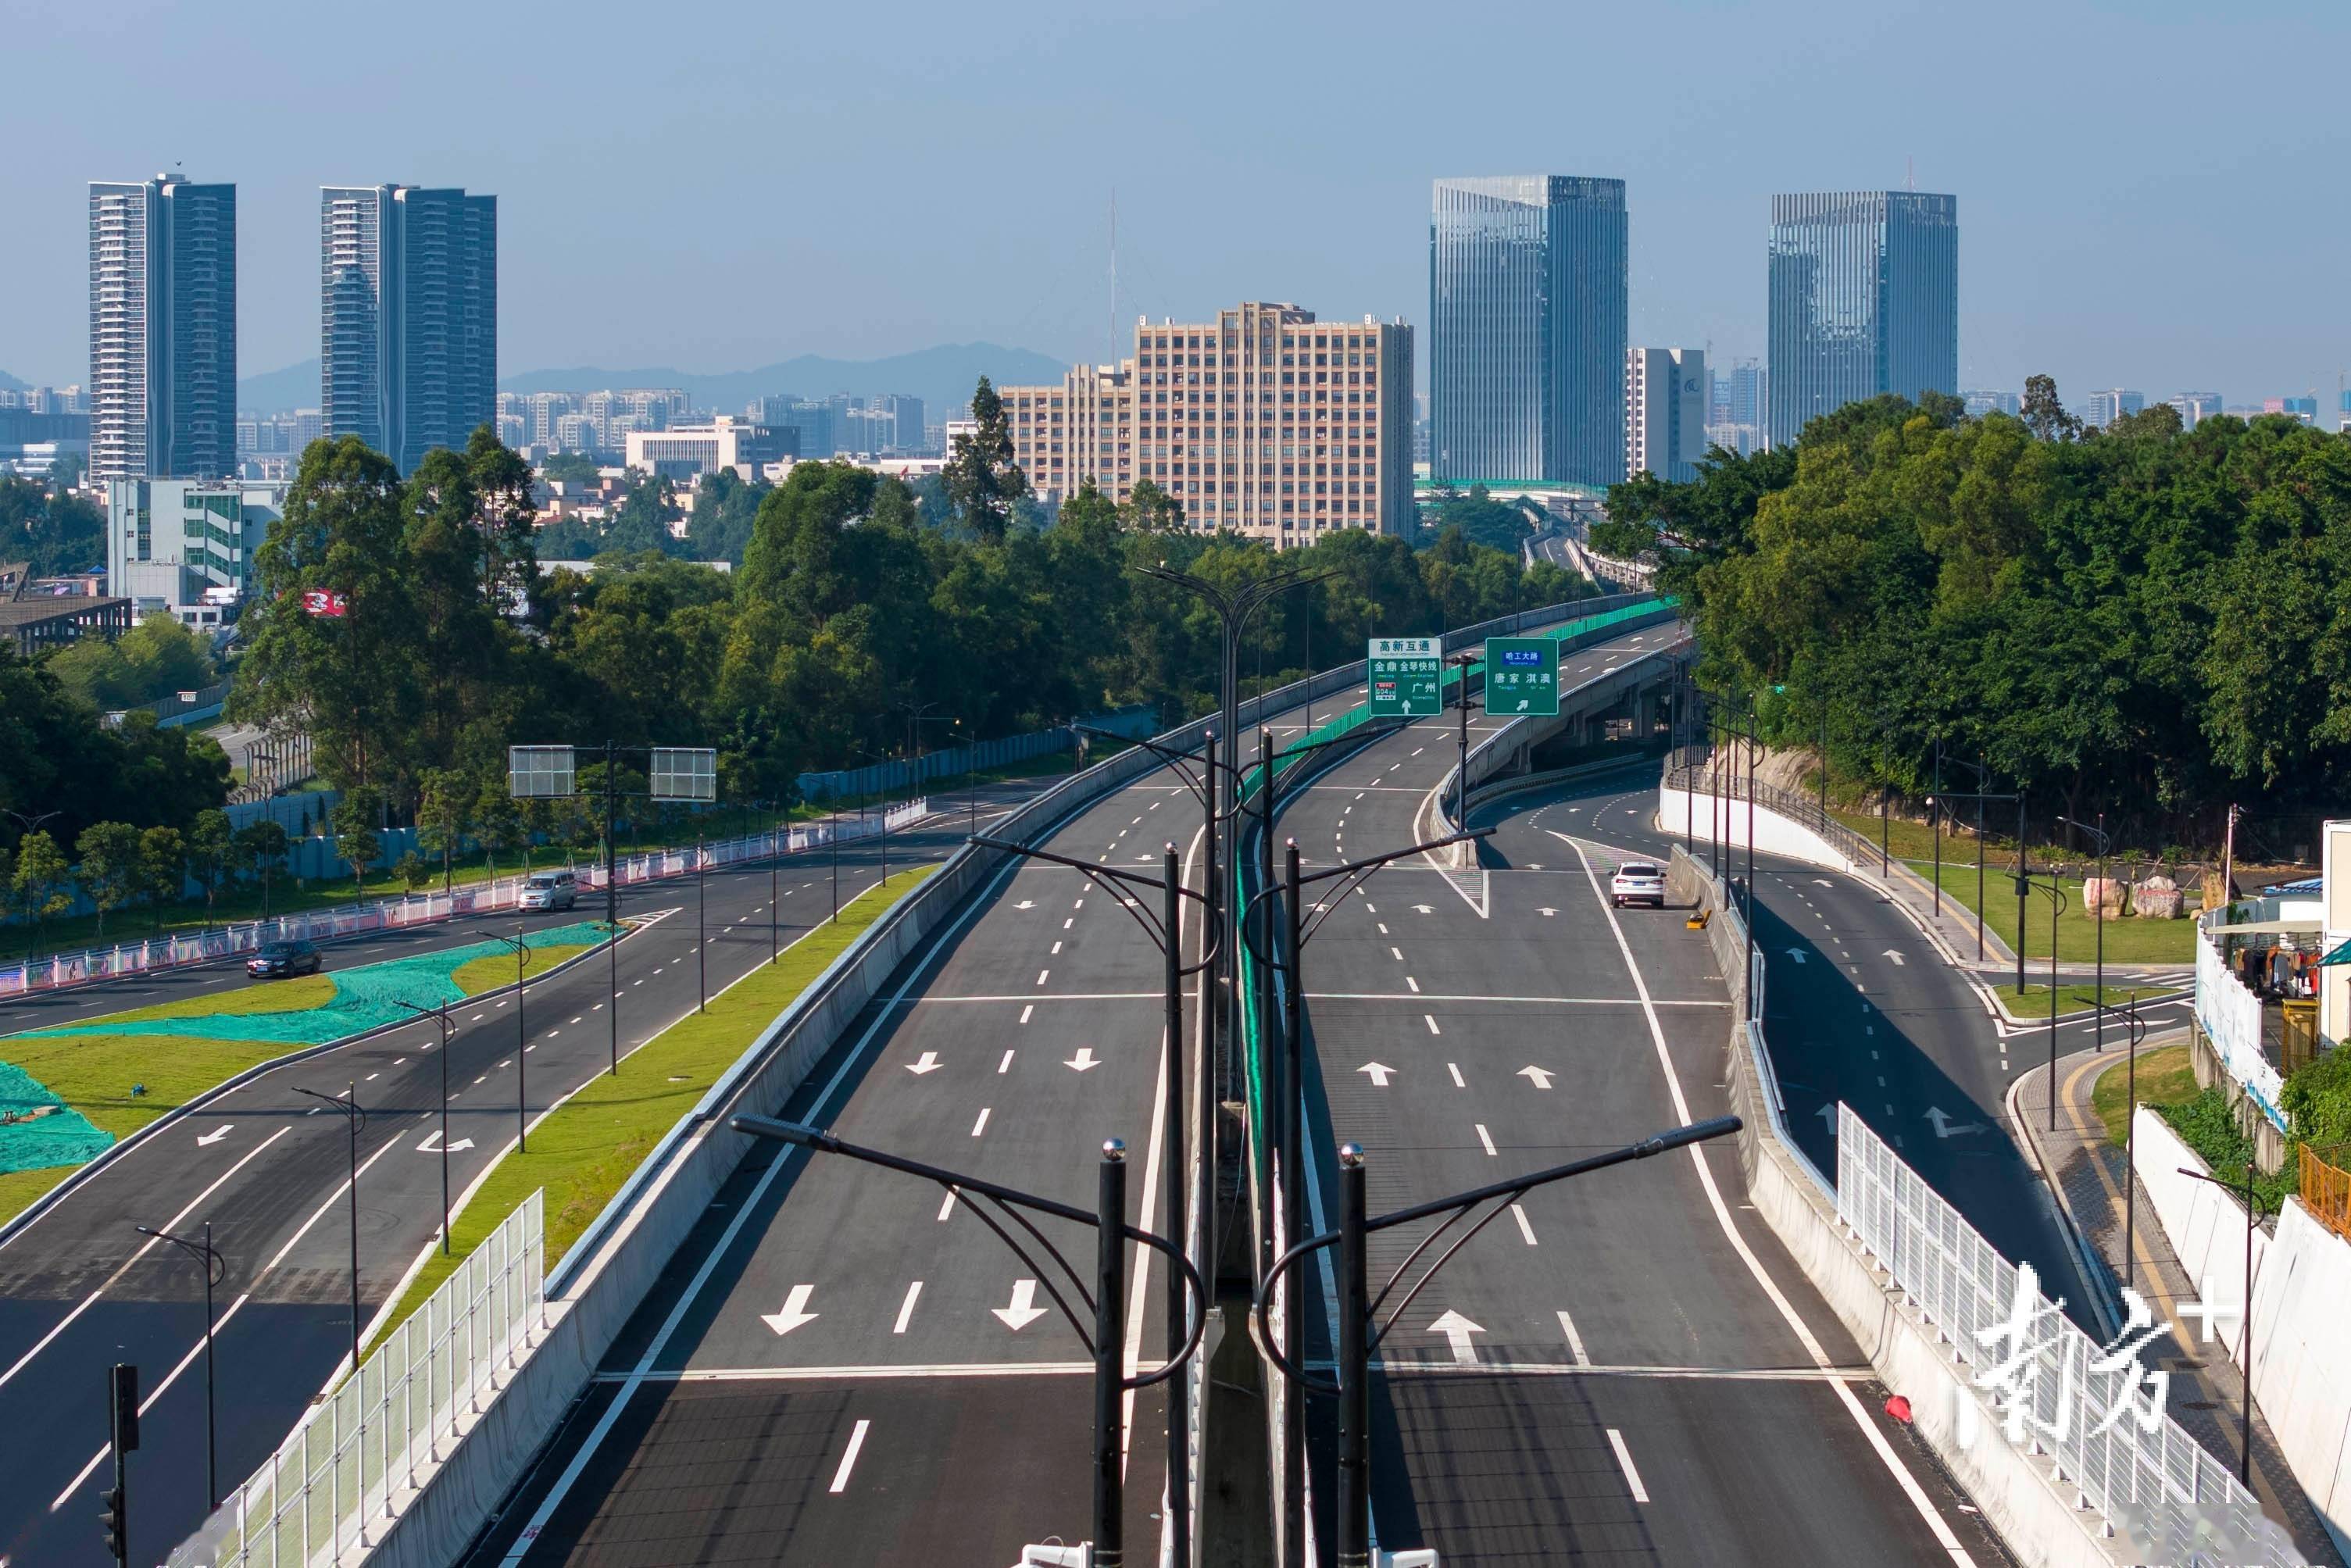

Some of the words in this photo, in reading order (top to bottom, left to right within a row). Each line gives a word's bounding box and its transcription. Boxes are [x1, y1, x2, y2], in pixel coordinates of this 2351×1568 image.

[1379, 640, 1430, 652] 高新互通
[1506, 652, 1538, 660] 哈工大路
[1374, 661, 1397, 672] 金鼎
[1399, 661, 1437, 672] 金琴快线
[1495, 673, 1520, 684] 唐家
[1412, 682, 1436, 693] 广州
